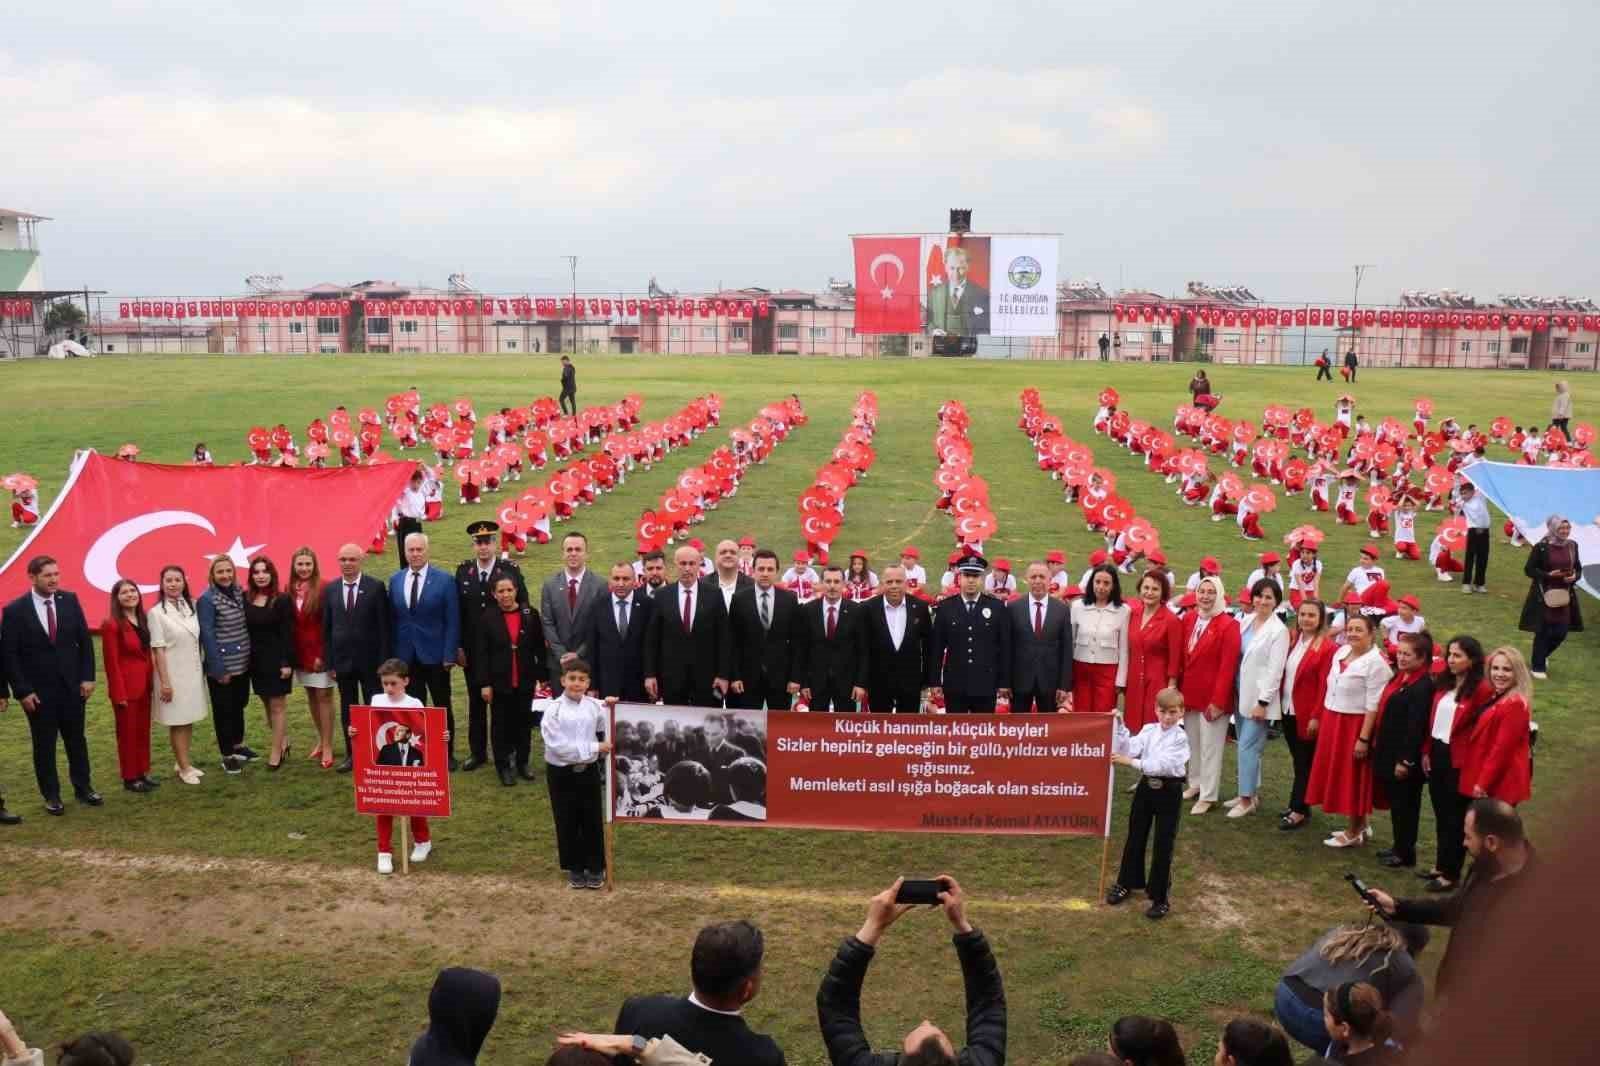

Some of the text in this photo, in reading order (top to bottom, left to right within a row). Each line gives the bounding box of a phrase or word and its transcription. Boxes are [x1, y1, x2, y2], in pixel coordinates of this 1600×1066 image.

[835, 719, 1048, 739] Küçük hanımlar,küçük beyler!
[777, 737, 1105, 759] Sizler hepiniz geleceğin bir gülü,yıldızı ve ikbal
[906, 762, 975, 777] ışığısınız.
[790, 777, 1089, 797] Memleketi asıl ışığa boğacak olan sizsiniz.
[921, 812, 1098, 829] Mustafa Kemal ATATÜRK
